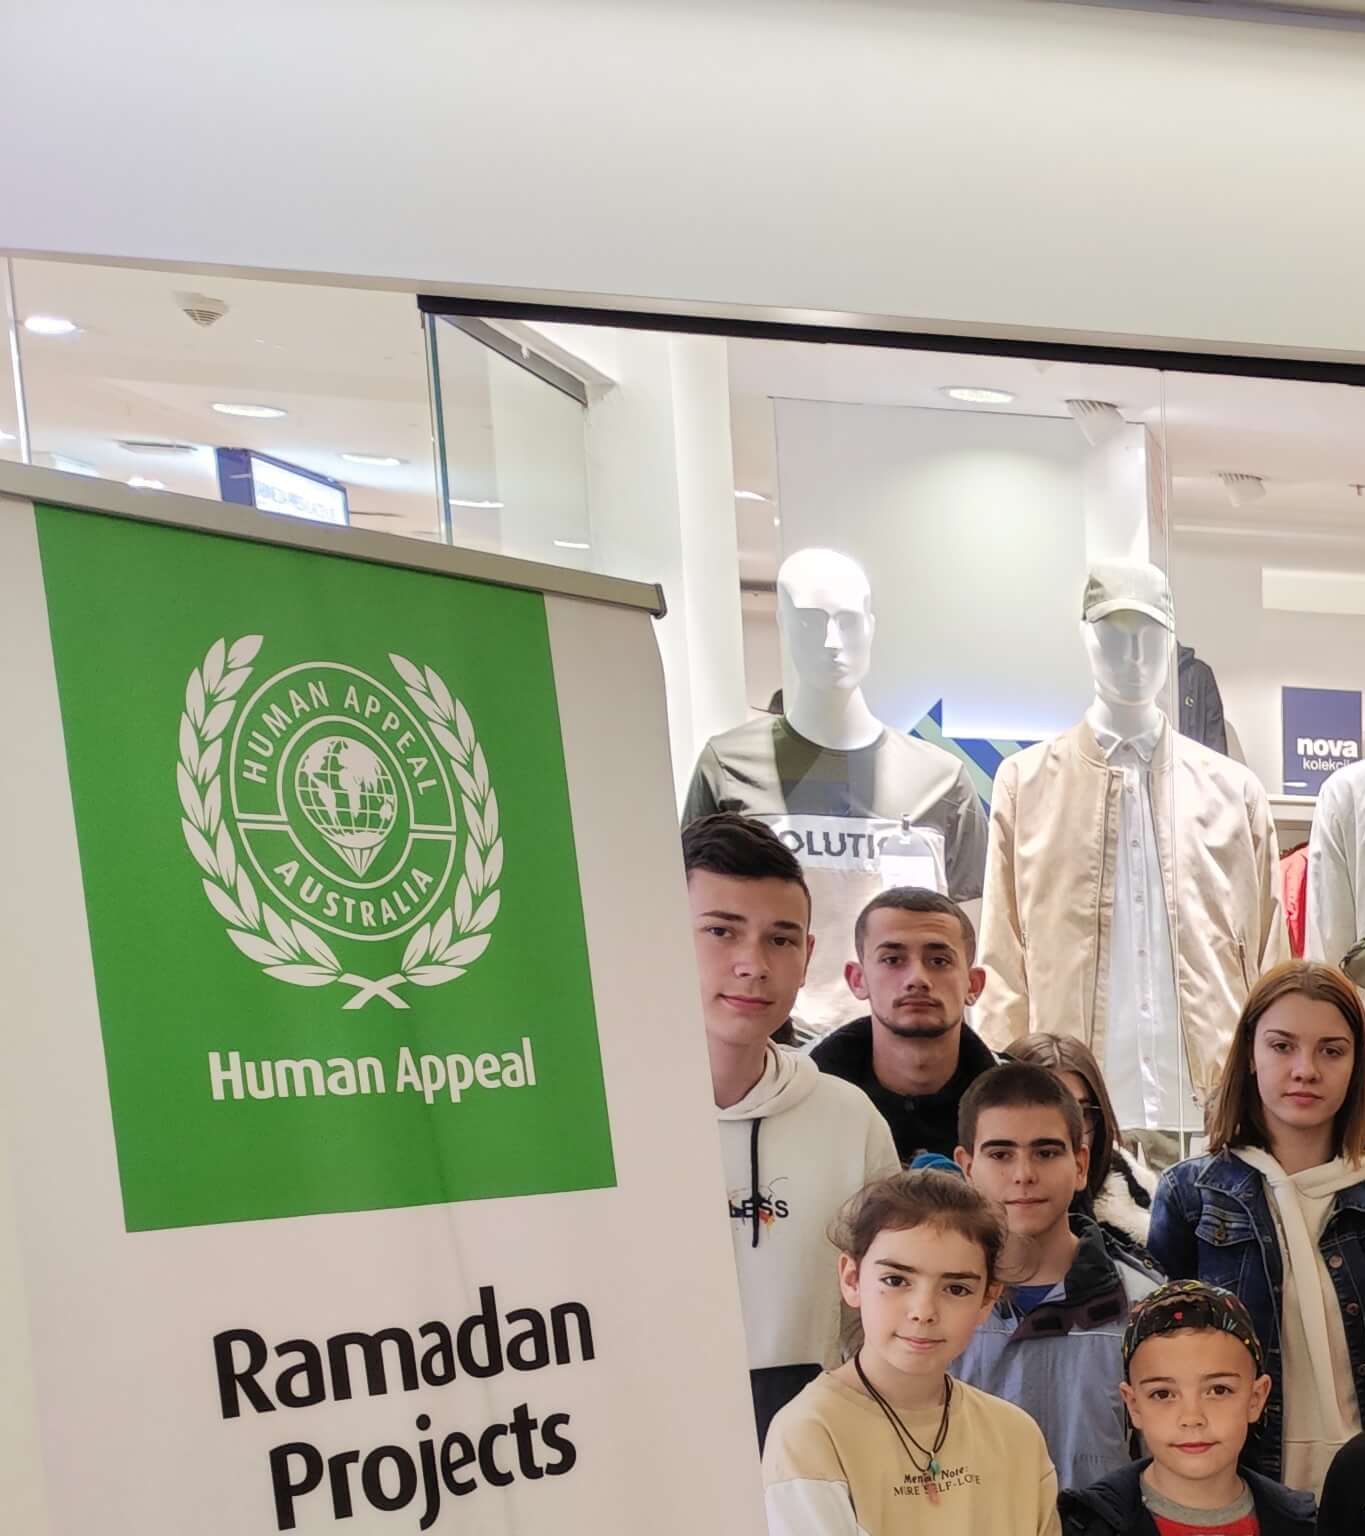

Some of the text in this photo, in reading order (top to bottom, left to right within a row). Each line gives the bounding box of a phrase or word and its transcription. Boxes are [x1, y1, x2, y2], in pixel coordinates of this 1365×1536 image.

[242, 681, 439, 796] HUMAN APPEAL
[1297, 738, 1358, 758] nova
[273, 859, 434, 928] AUSTRALIA
[208, 1037, 537, 1105] Human Appeal
[213, 1285, 596, 1419] Ramadan
[269, 1403, 577, 1531] Projects
